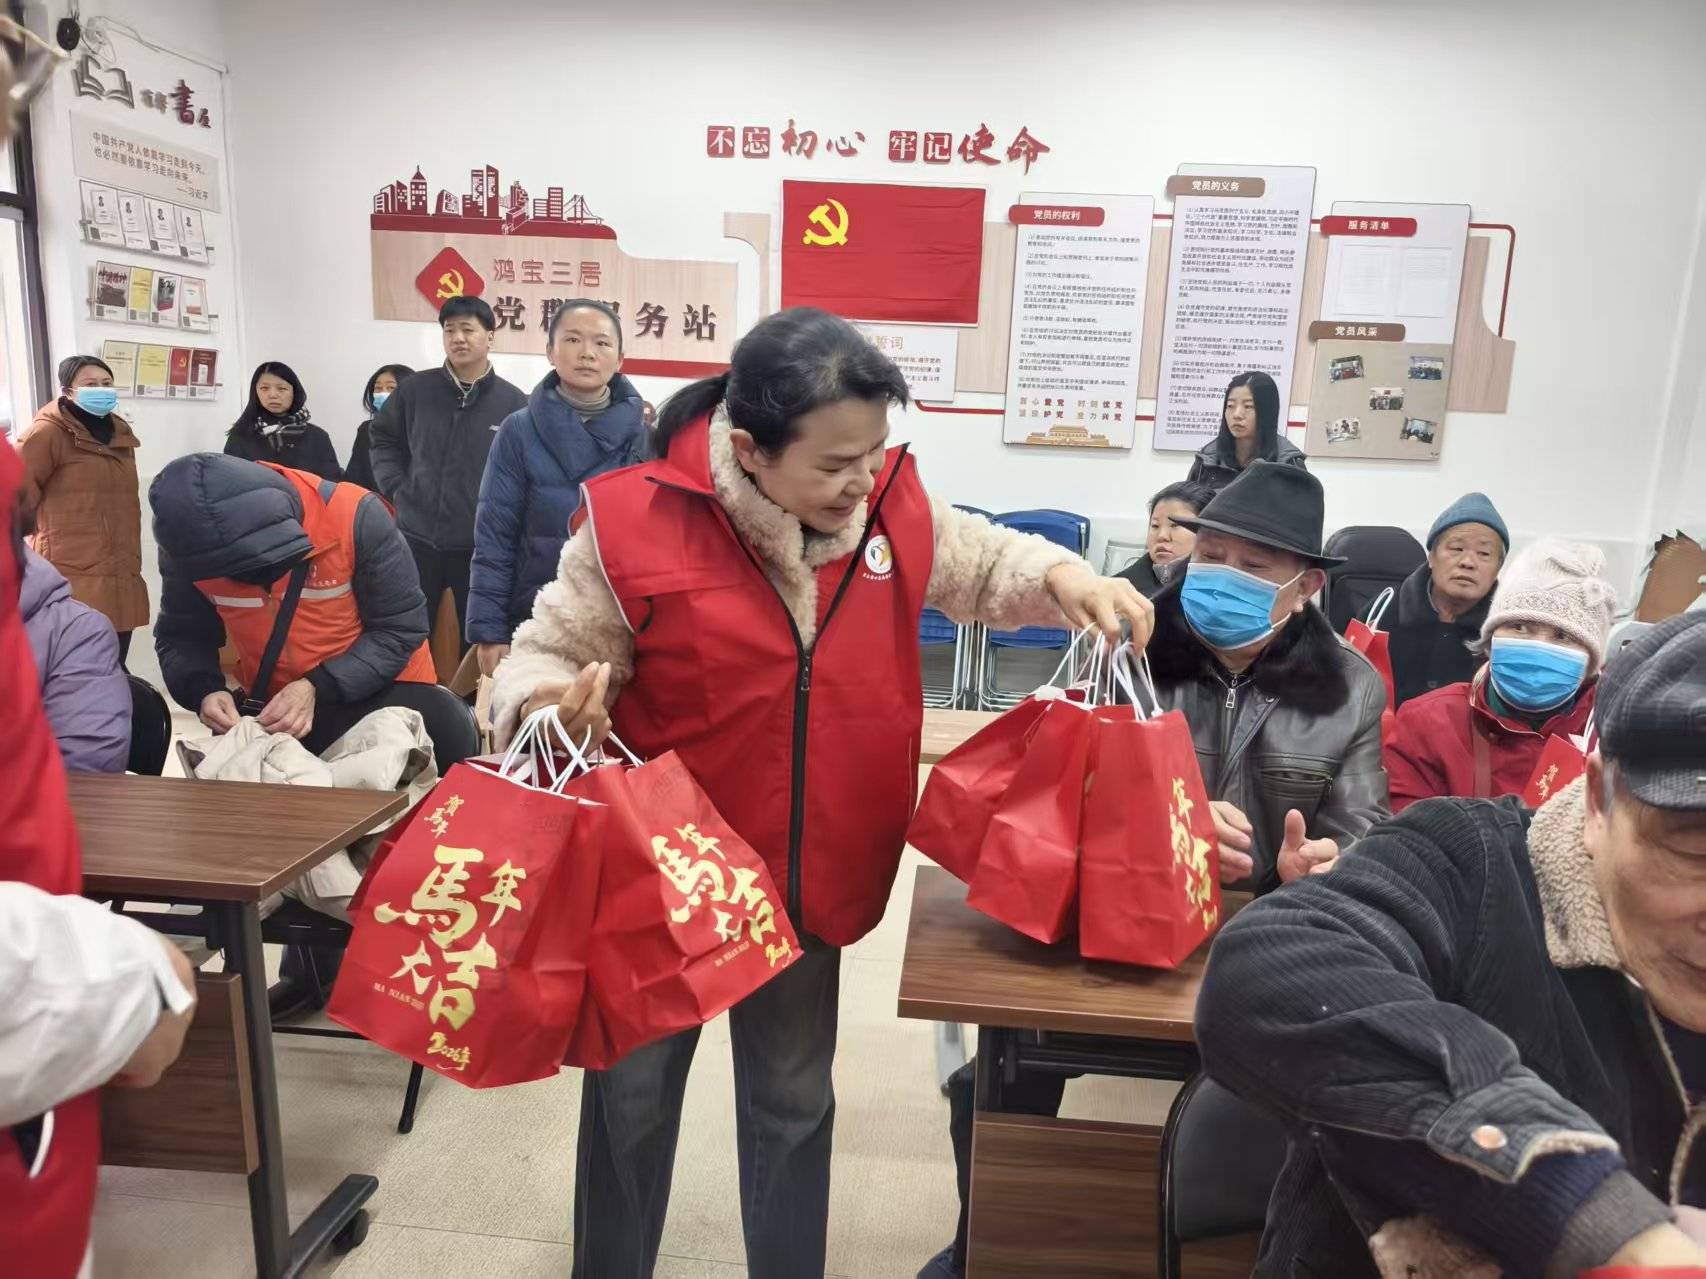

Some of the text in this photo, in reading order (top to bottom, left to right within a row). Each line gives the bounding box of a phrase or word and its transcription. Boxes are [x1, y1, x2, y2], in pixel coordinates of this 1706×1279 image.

[707, 119, 1051, 175] 不忘初心 牢记使命
[1191, 180, 1240, 191] 党员的义务
[1033, 209, 1081, 221] 党员的权利
[1348, 220, 1391, 231] 服务清单
[493, 258, 602, 288] 鸿宝三居
[492, 296, 717, 341] 党群务站
[1334, 326, 1378, 338] 党员风采
[427, 1031, 472, 1071] 2026年
